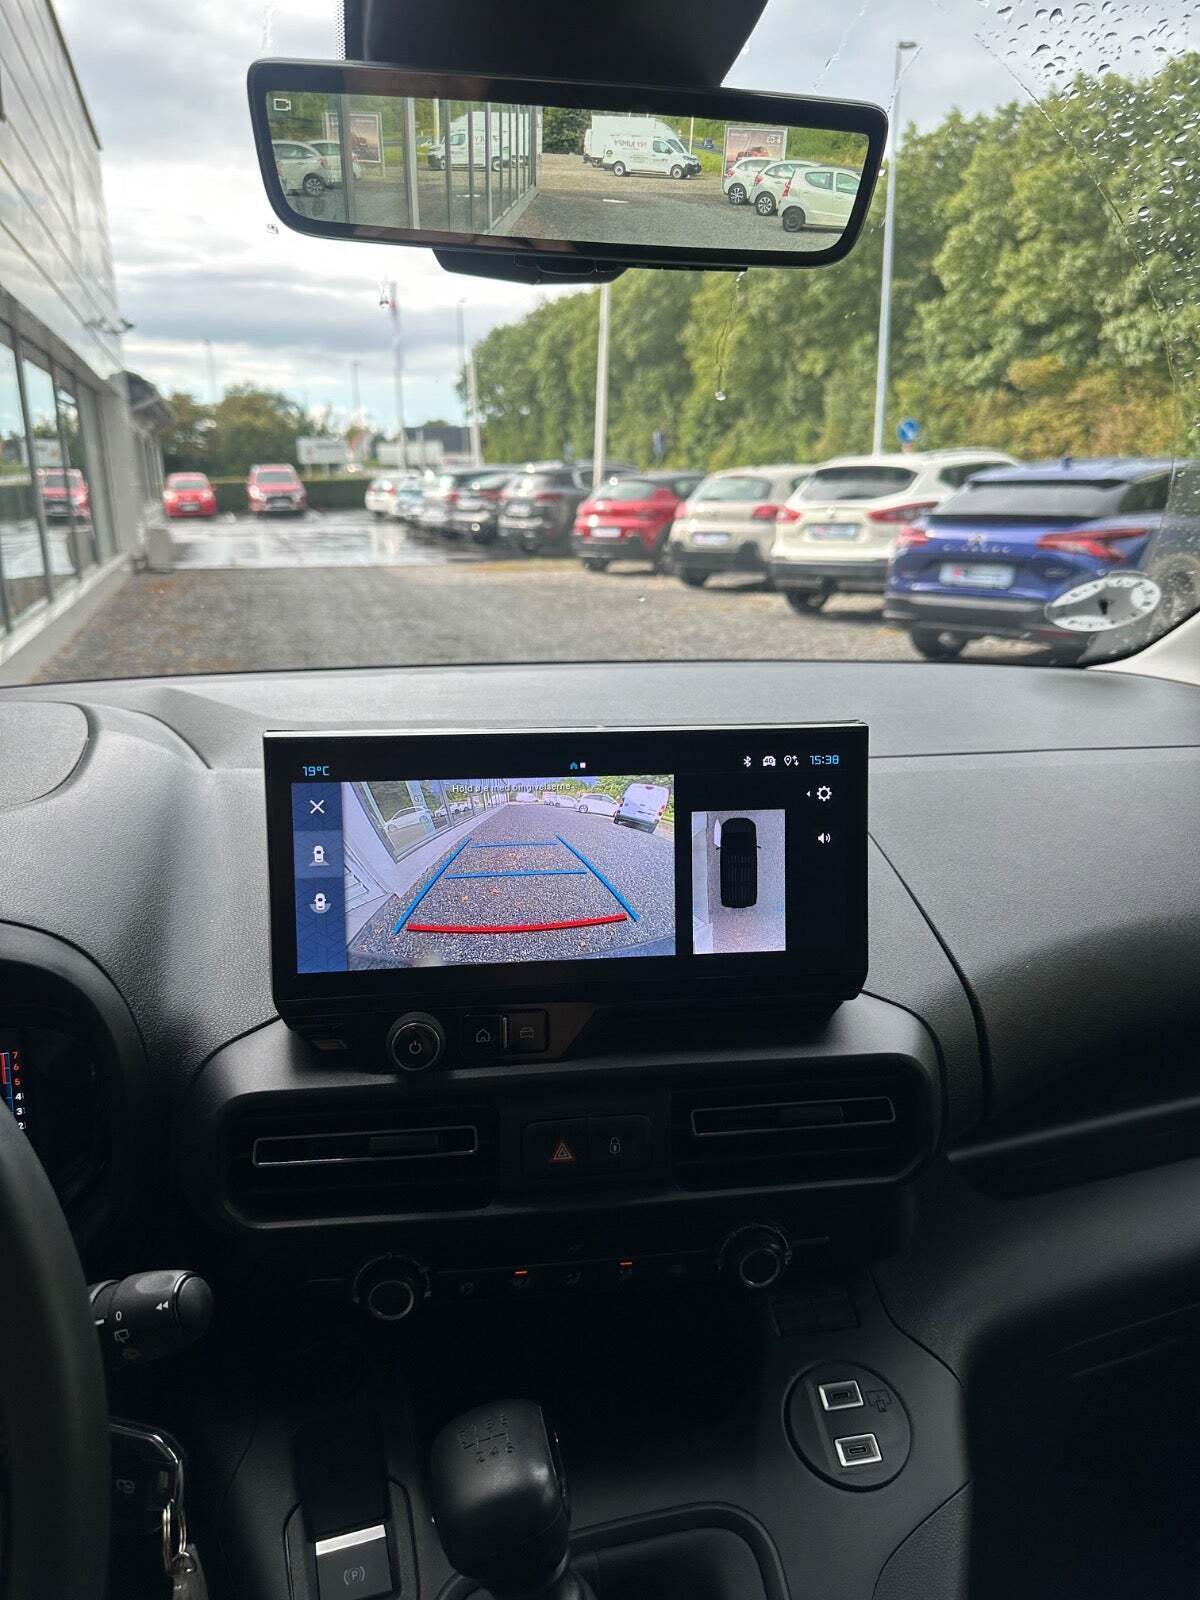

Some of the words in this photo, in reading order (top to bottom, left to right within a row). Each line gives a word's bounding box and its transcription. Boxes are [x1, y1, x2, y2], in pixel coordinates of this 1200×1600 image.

[809, 754, 840, 766] 15:38
[302, 765, 330, 777] 19°C
[452, 784, 473, 793] Hold
[12, 1052, 18, 1060] 7
[15, 1078, 21, 1086] 5
[18, 1122, 25, 1130] 2
